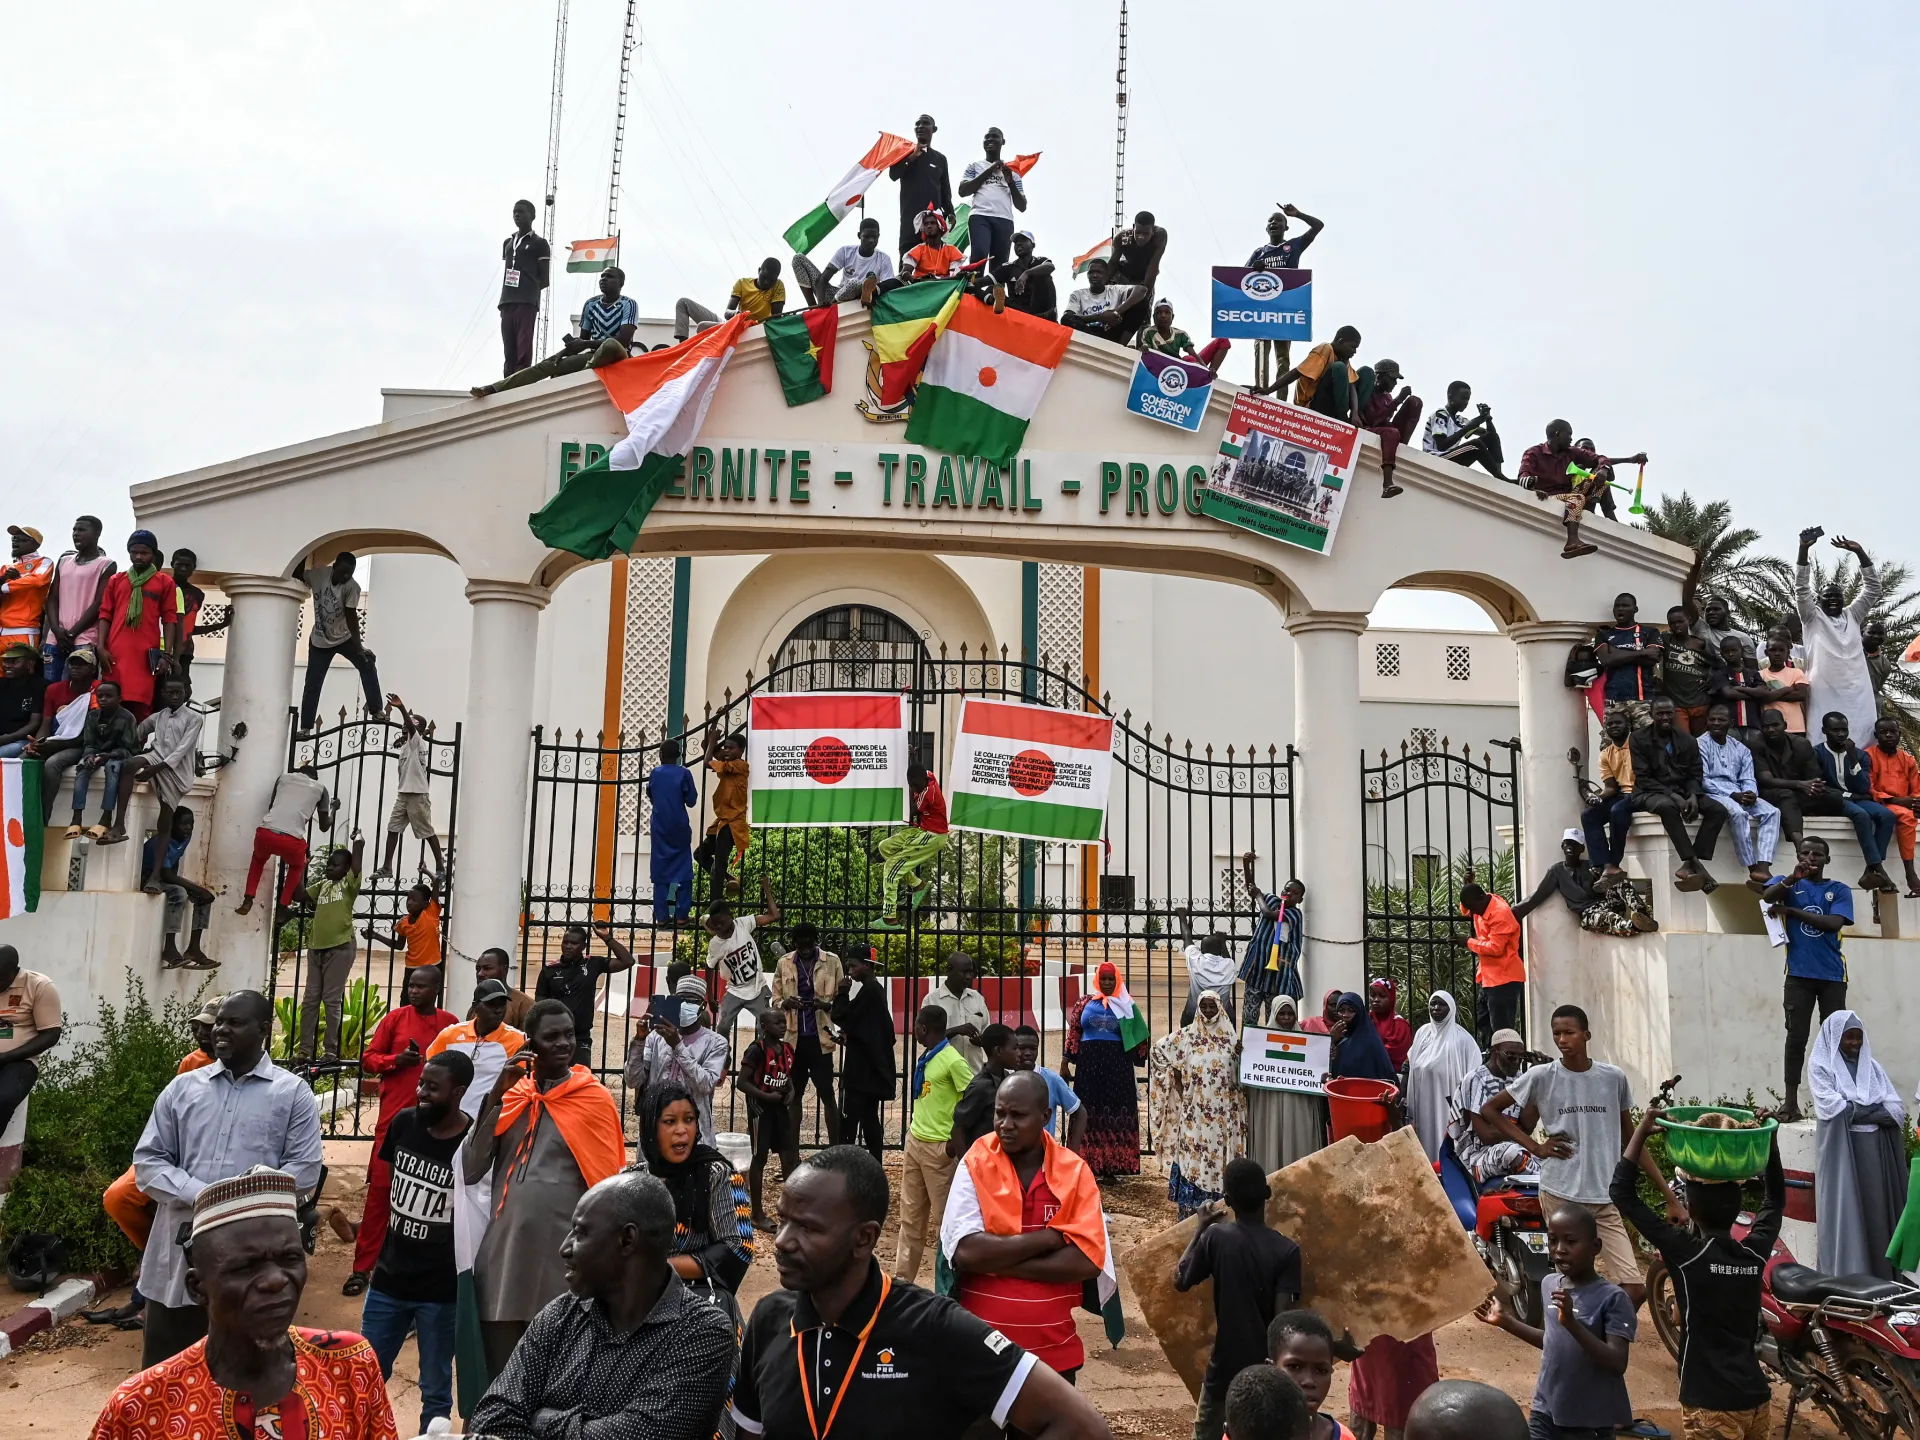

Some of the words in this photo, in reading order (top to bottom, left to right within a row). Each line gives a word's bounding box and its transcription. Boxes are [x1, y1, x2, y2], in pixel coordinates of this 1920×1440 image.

[1217, 310, 1306, 325] SECURITÉ
[1141, 393, 1192, 416] COHÉSION
[1141, 403, 1185, 424] SOCIALE
[1262, 402, 1283, 413] apporte
[1284, 408, 1293, 416] son
[1294, 412, 1314, 422] soutien
[1240, 414, 1246, 422] la
[1281, 428, 1288, 436] et
[1312, 438, 1320, 446] de
[1320, 440, 1326, 448] la
[1282, 419, 1301, 430] peuple
[1301, 424, 1320, 436] debout
[1320, 431, 1333, 440] pour
[559, 442, 811, 502] FRERNITE
[878, 453, 1043, 512] TRAVAIL
[1211, 493, 1222, 503] Bas
[1269, 513, 1307, 530] monstrueux
[1316, 528, 1328, 537] ses
[1238, 515, 1257, 527] valets
[973, 757, 1000, 766] SOCIETE
[1001, 760, 1020, 768] CIVILE
[1022, 763, 1057, 773] NIGERIENNE
[982, 752, 1015, 760] COLLECTIF
[1028, 757, 1074, 769] ORGANISATIONS
[972, 770, 1004, 779] DECISIONS
[1005, 773, 1027, 782] PRISES
[1053, 780, 1090, 789] NOUVELLES
[973, 764, 1005, 773] AUTORITES
[1006, 768, 1042, 778] FRANCAISES
[1052, 774, 1078, 782] RESPECT
[971, 776, 1007, 786] AUTORITES
[1008, 781, 1049, 791] NIGERIENNES
[724, 941, 753, 971] INTER
[1252, 1063, 1275, 1073] POUR
[1277, 1066, 1286, 1074] LE
[1288, 1067, 1315, 1078] NIGER,
[1253, 1074, 1264, 1082] NE
[1266, 1076, 1296, 1086] RECULE
[1298, 1079, 1323, 1089] POINT
[395, 1150, 455, 1186] STRAIGHT
[391, 1174, 448, 1218] OUTTA
[402, 1219, 429, 1240] BED
